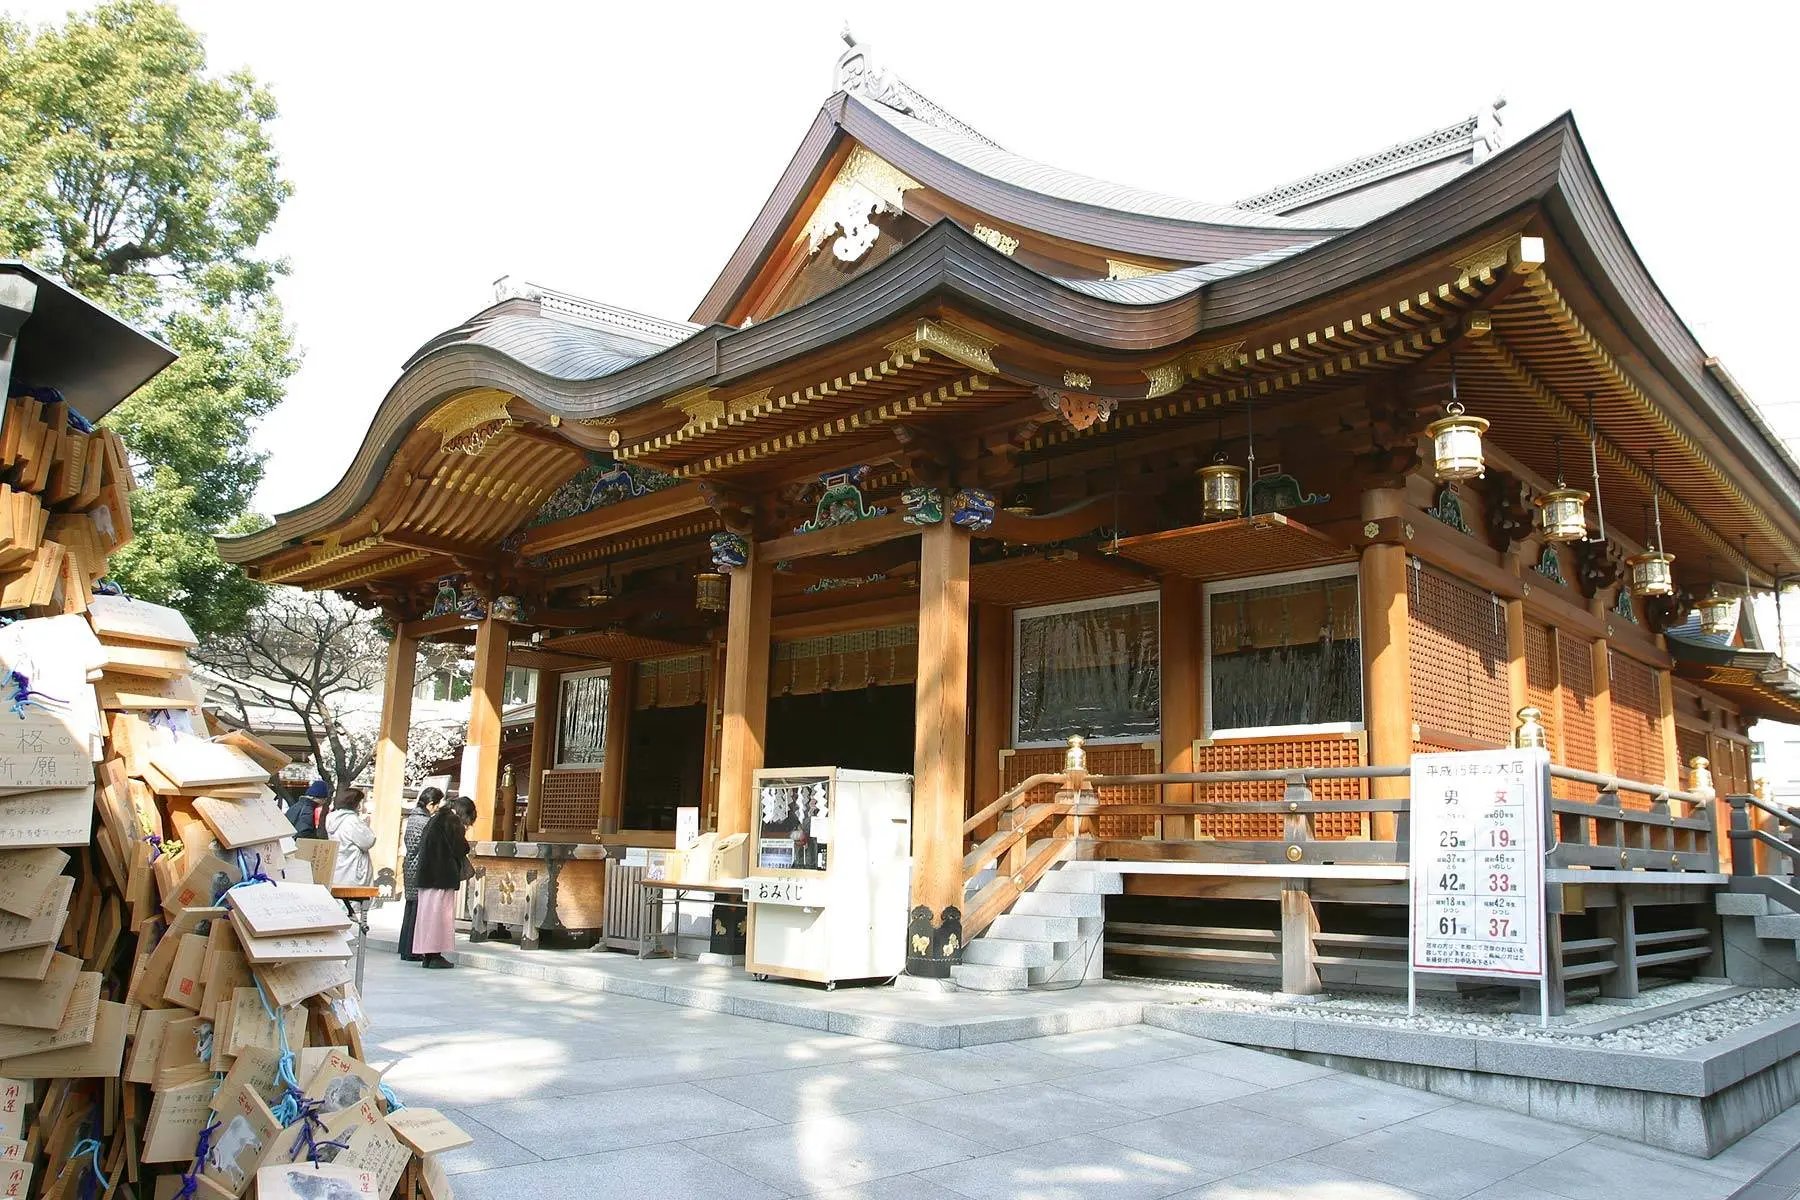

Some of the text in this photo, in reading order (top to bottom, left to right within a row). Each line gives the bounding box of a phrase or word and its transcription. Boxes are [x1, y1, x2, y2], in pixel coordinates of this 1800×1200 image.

[1444, 790, 1458, 805] 男
[1494, 790, 1508, 804] 女
[759, 883, 803, 900] おみくじ
